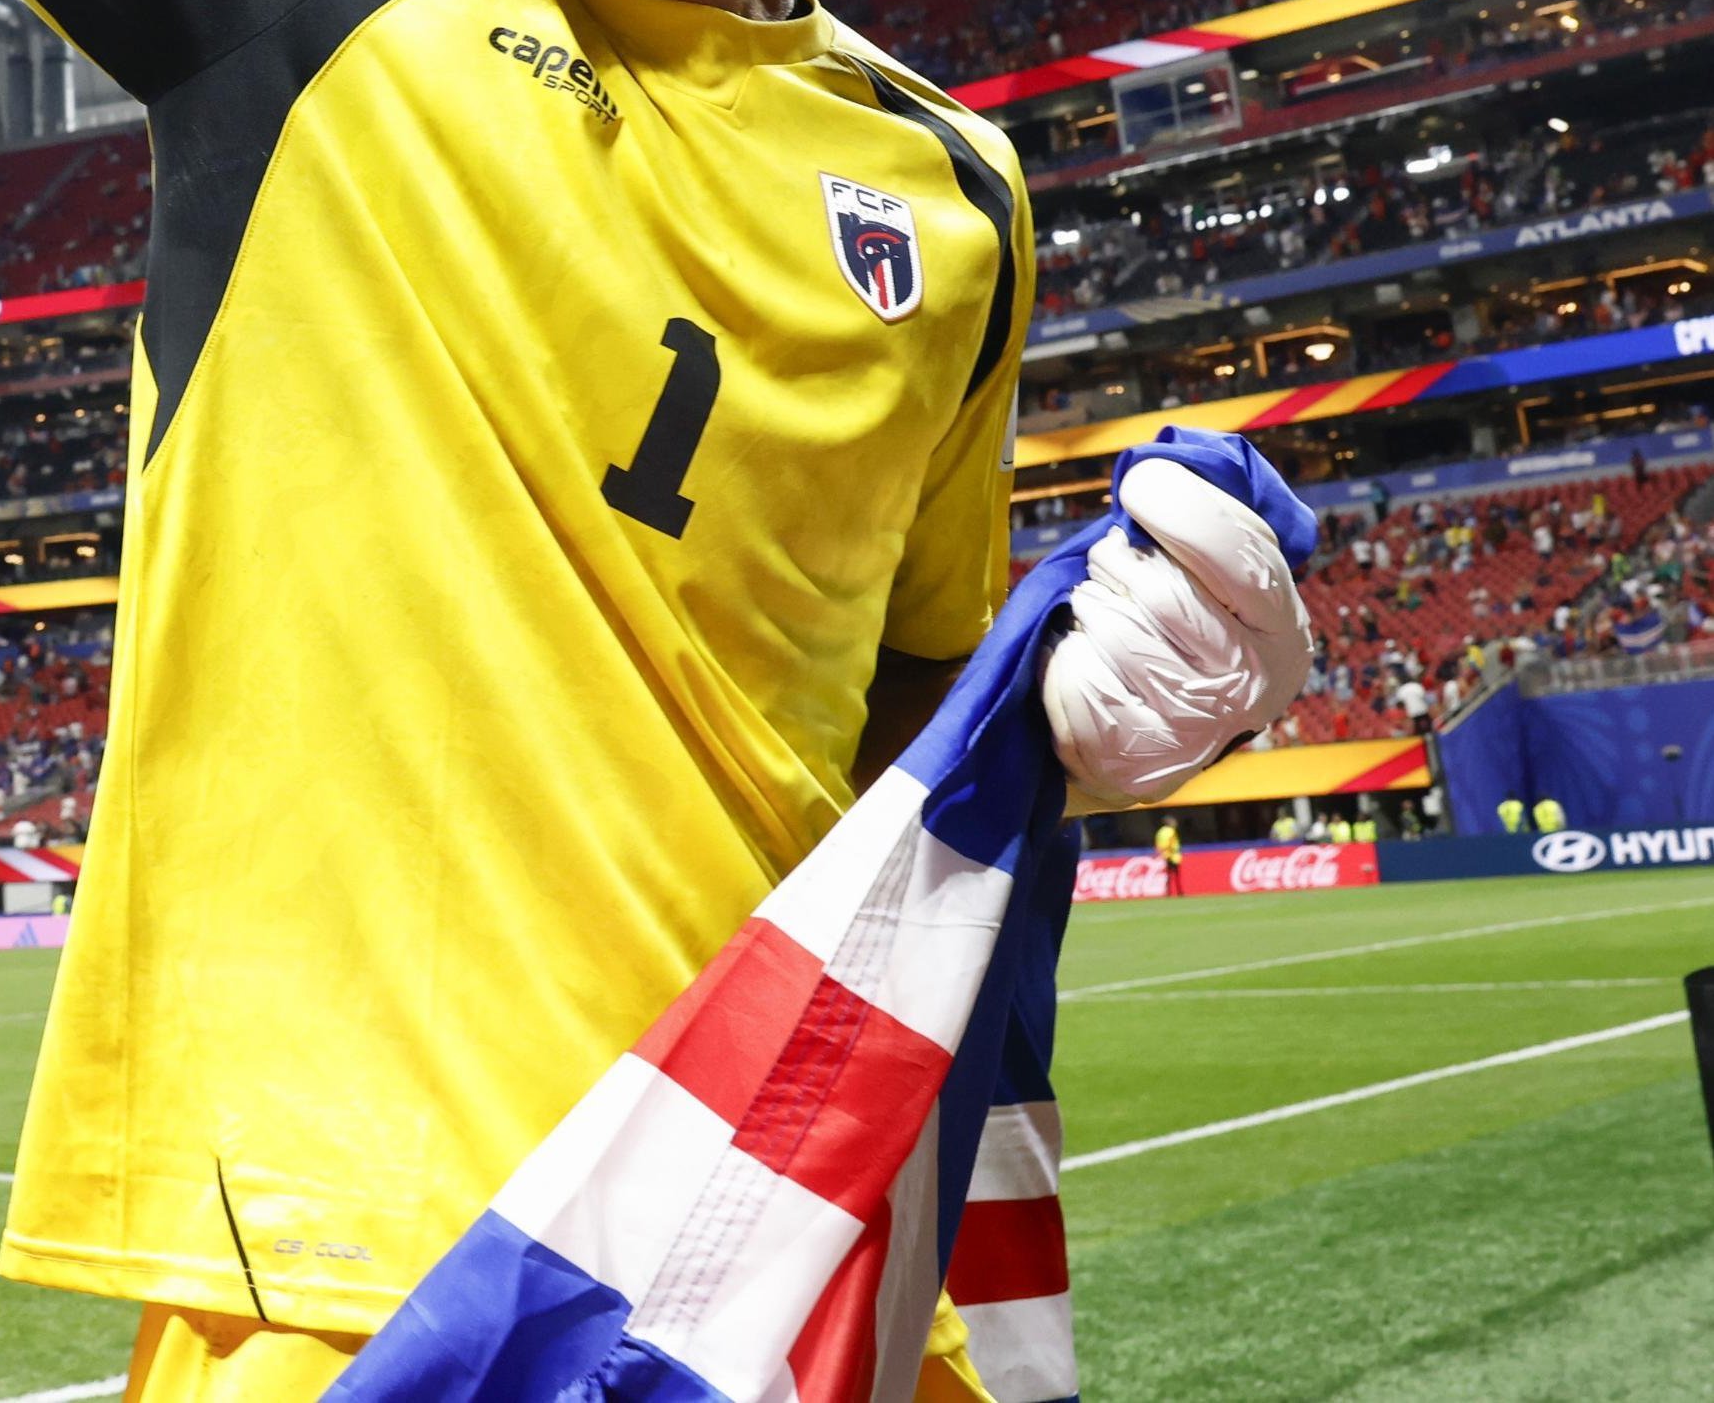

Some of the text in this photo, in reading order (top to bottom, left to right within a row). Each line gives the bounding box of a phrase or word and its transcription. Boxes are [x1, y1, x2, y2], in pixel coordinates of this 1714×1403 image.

[543, 74, 616, 124] SPORT
[831, 181, 903, 214] FCF
[1515, 201, 1673, 247] ATLANTA
[600, 317, 721, 540] 1
